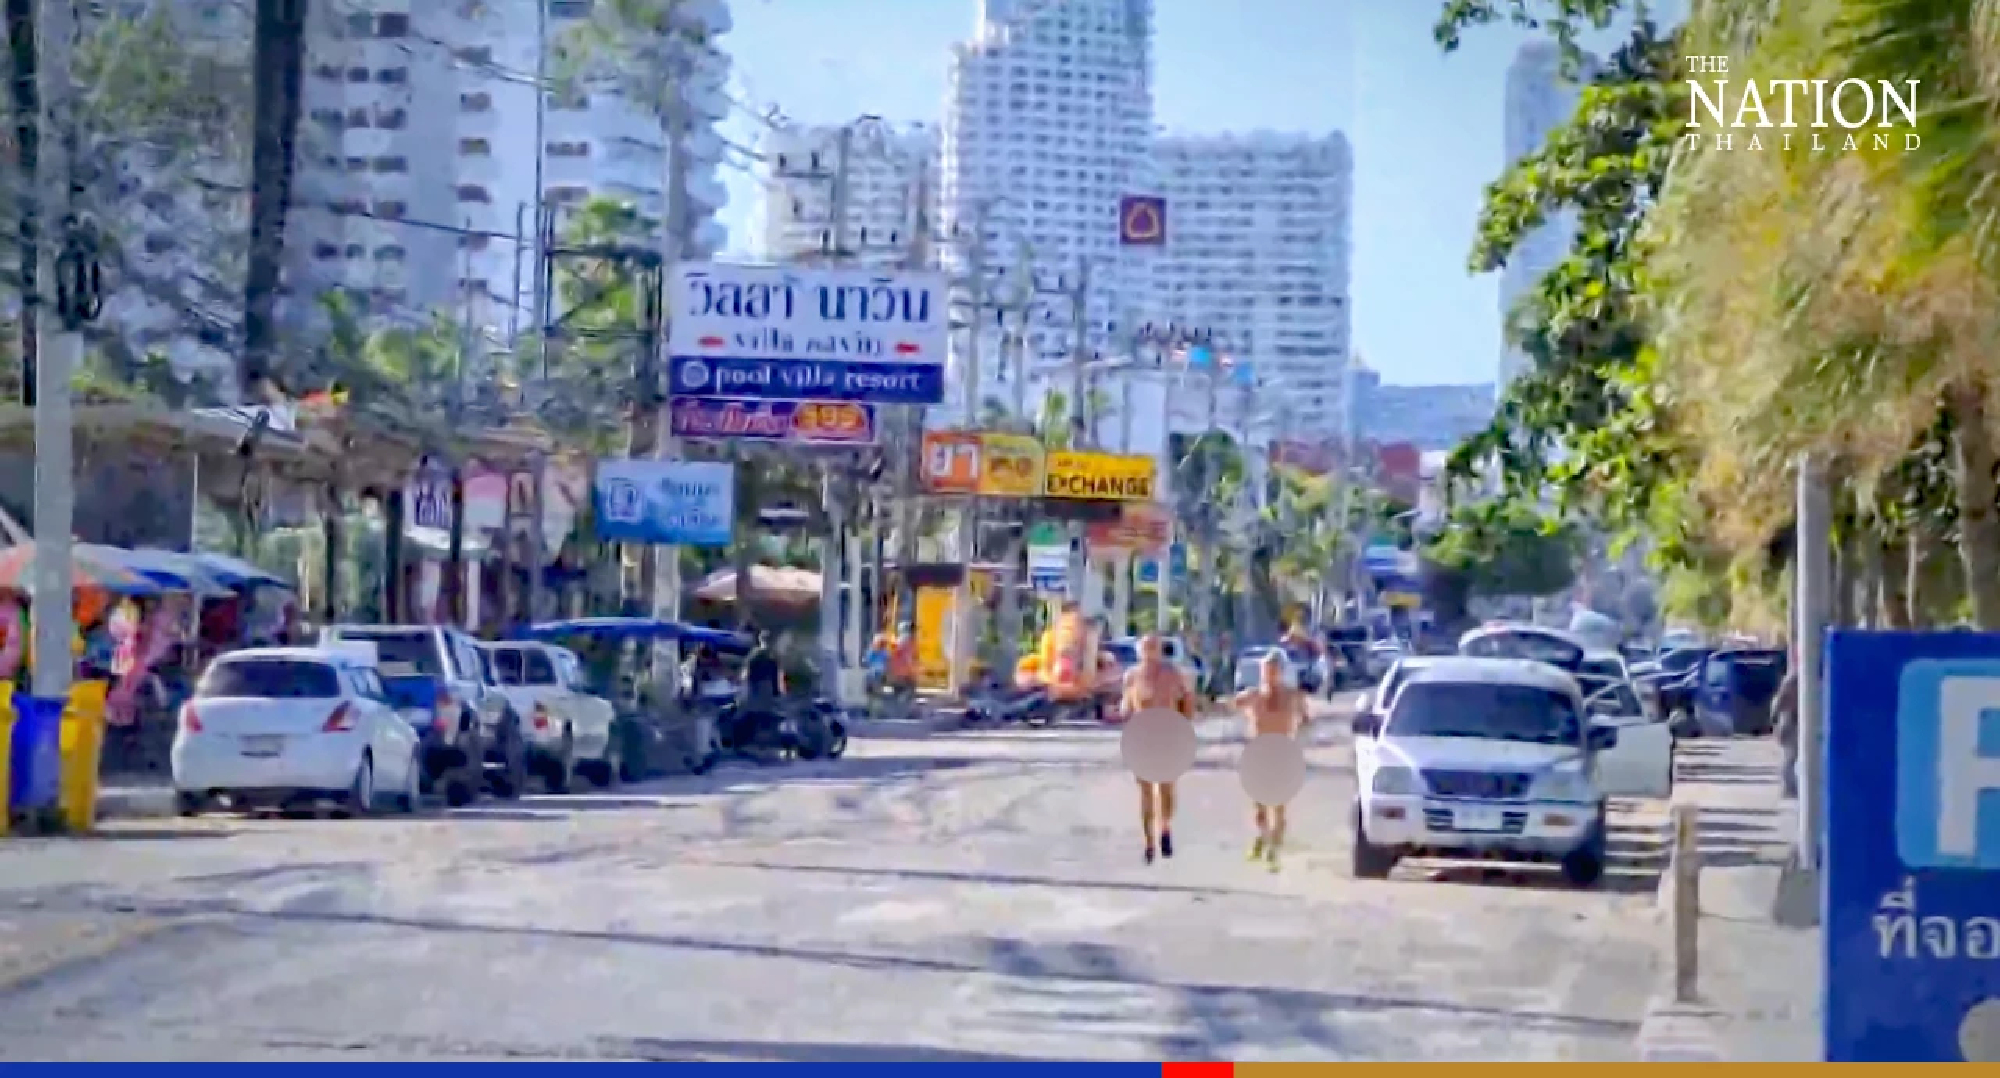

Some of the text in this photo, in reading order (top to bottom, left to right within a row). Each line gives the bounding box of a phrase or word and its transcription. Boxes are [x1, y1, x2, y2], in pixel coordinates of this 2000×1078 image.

[816, 276, 931, 323] นาวิน
[715, 364, 920, 393] pool villa resort
